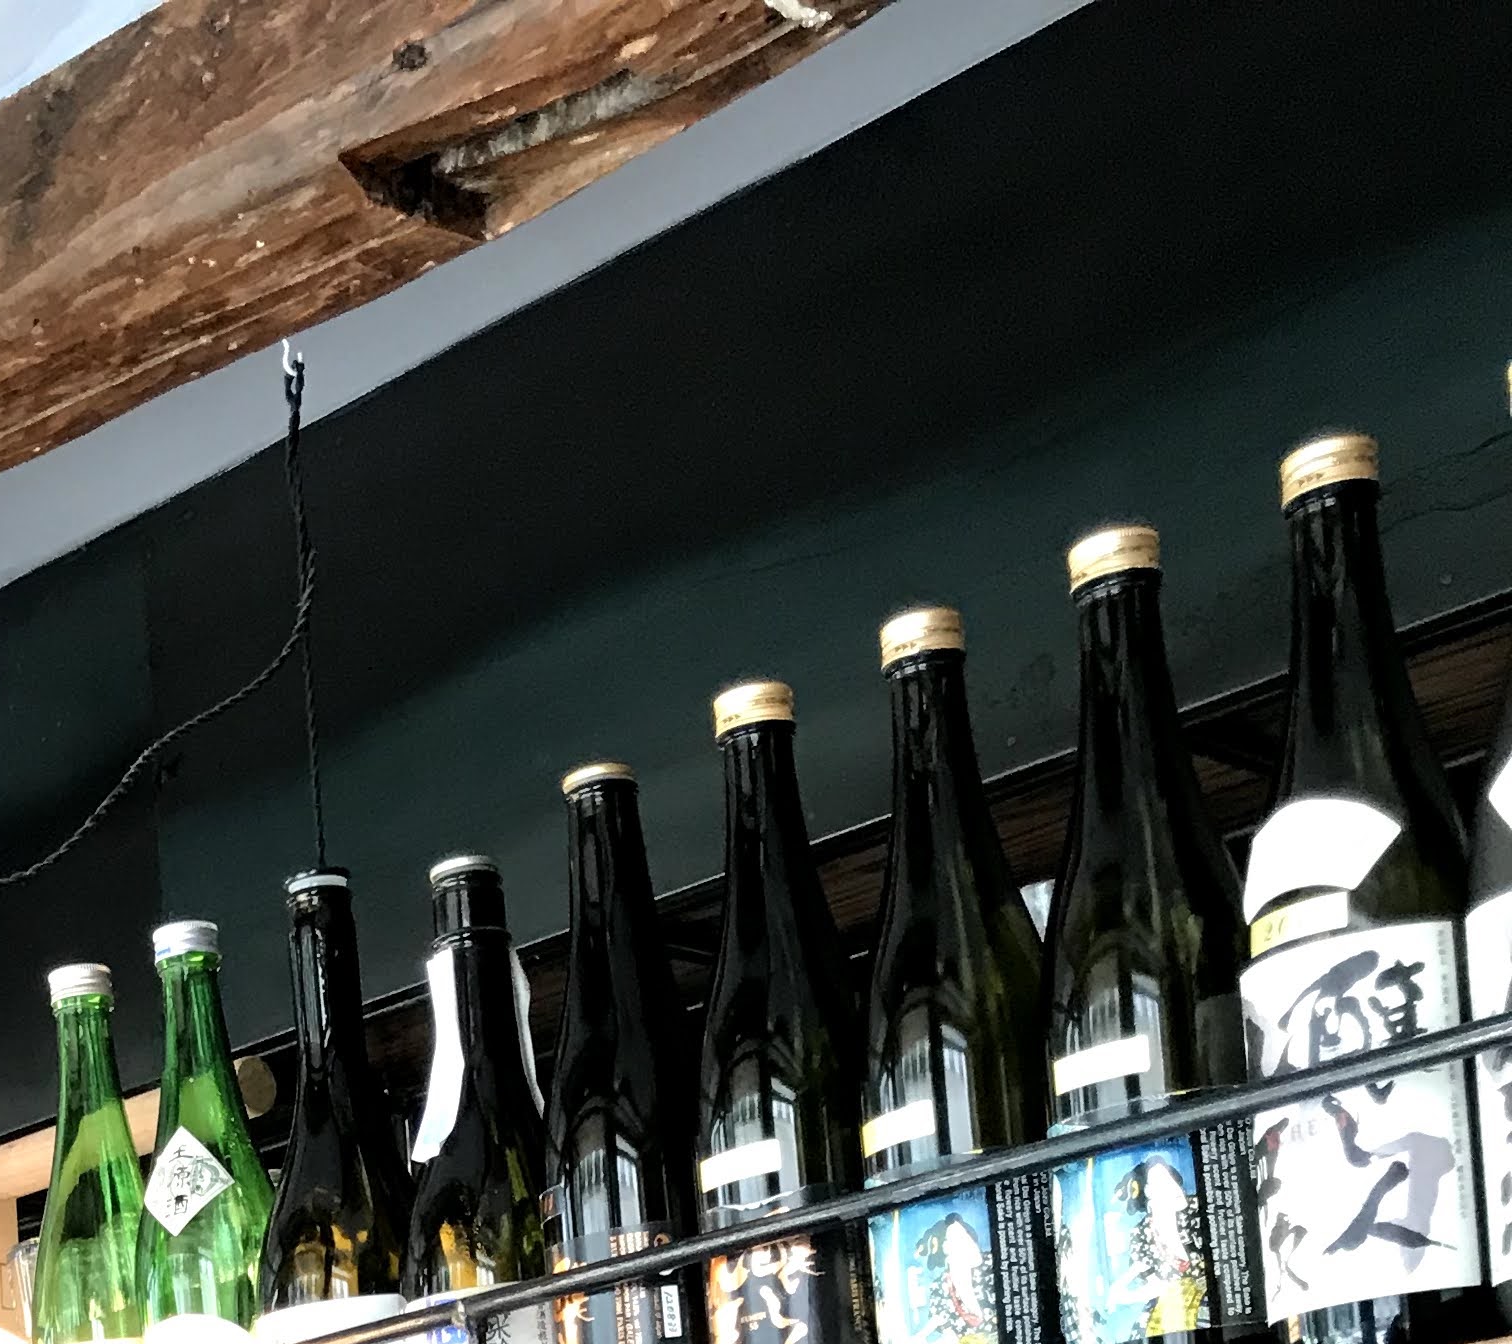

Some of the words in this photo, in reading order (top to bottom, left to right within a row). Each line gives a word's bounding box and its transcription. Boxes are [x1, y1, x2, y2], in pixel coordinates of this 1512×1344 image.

[1220, 1153, 1228, 1169] with
[1211, 1163, 1221, 1186] scent
[1221, 1172, 1229, 1188] over
[1013, 1196, 1021, 1210] rice
[1032, 1188, 1042, 1213] Japan
[1214, 1190, 1223, 1205] and
[1231, 1181, 1242, 1214] premium
[995, 1202, 1005, 1221] Sake
[1006, 1222, 1016, 1244] scent
[1235, 1215, 1244, 1234] Sake
[997, 1230, 1008, 1260] possible
[1015, 1229, 1024, 1246] over
[1009, 1247, 1017, 1262] and
[1025, 1239, 1035, 1270] premium
[1220, 1239, 1229, 1259] taste
[1028, 1272, 1037, 1290] Sake
[1220, 1263, 1233, 1303] compared
[1229, 1259, 1240, 1291] polished
[1240, 1271, 1249, 1285] The
[1012, 1295, 1022, 1315] taste
[1242, 1287, 1251, 1306] Sake
[1004, 1304, 1012, 1316] the
[1033, 1326, 1042, 1340] The
